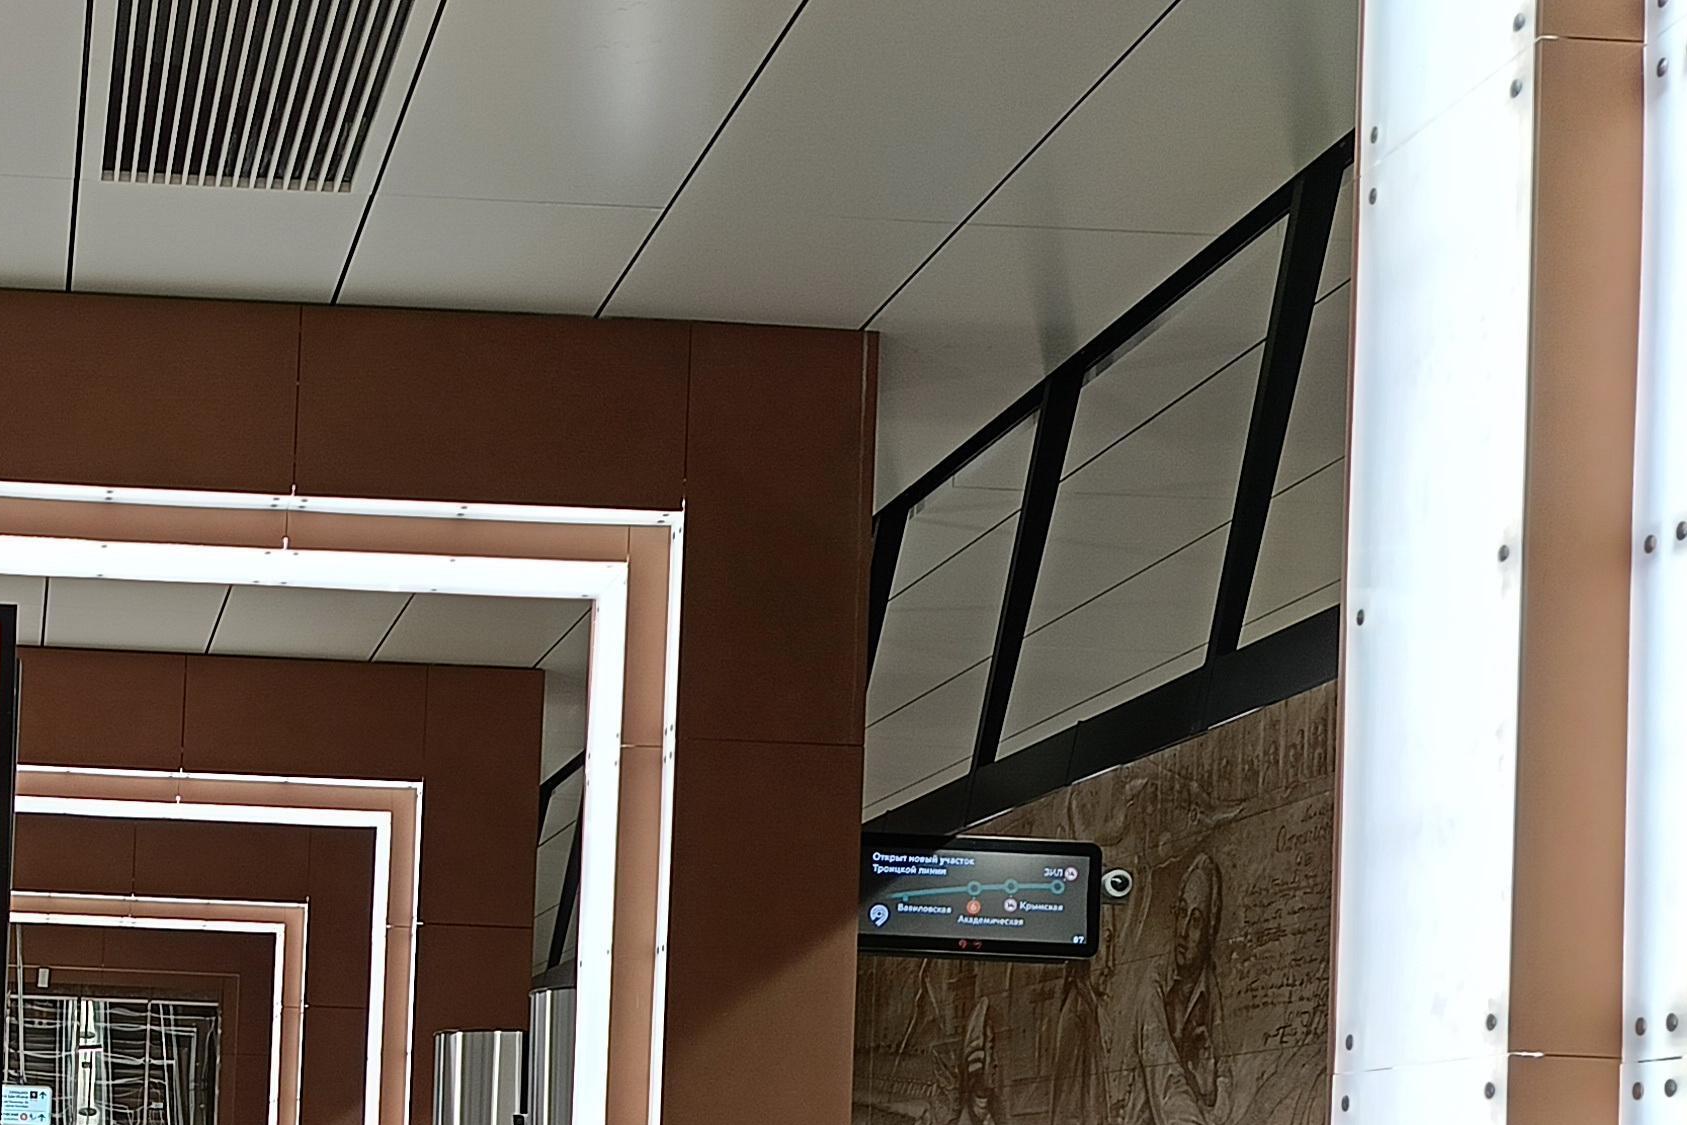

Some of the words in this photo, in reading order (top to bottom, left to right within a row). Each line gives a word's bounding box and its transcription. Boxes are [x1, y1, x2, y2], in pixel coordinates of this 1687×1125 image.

[872, 852, 907, 864] Открыт
[909, 855, 938, 865] новый
[939, 857, 975, 867] участок
[872, 864, 916, 875] Троицкой
[917, 867, 947, 876] линии
[1044, 868, 1064, 877] ЗИЛ
[897, 903, 952, 914] Вавиловская
[1019, 902, 1064, 912] Крымская
[957, 915, 1024, 927] Академическая
